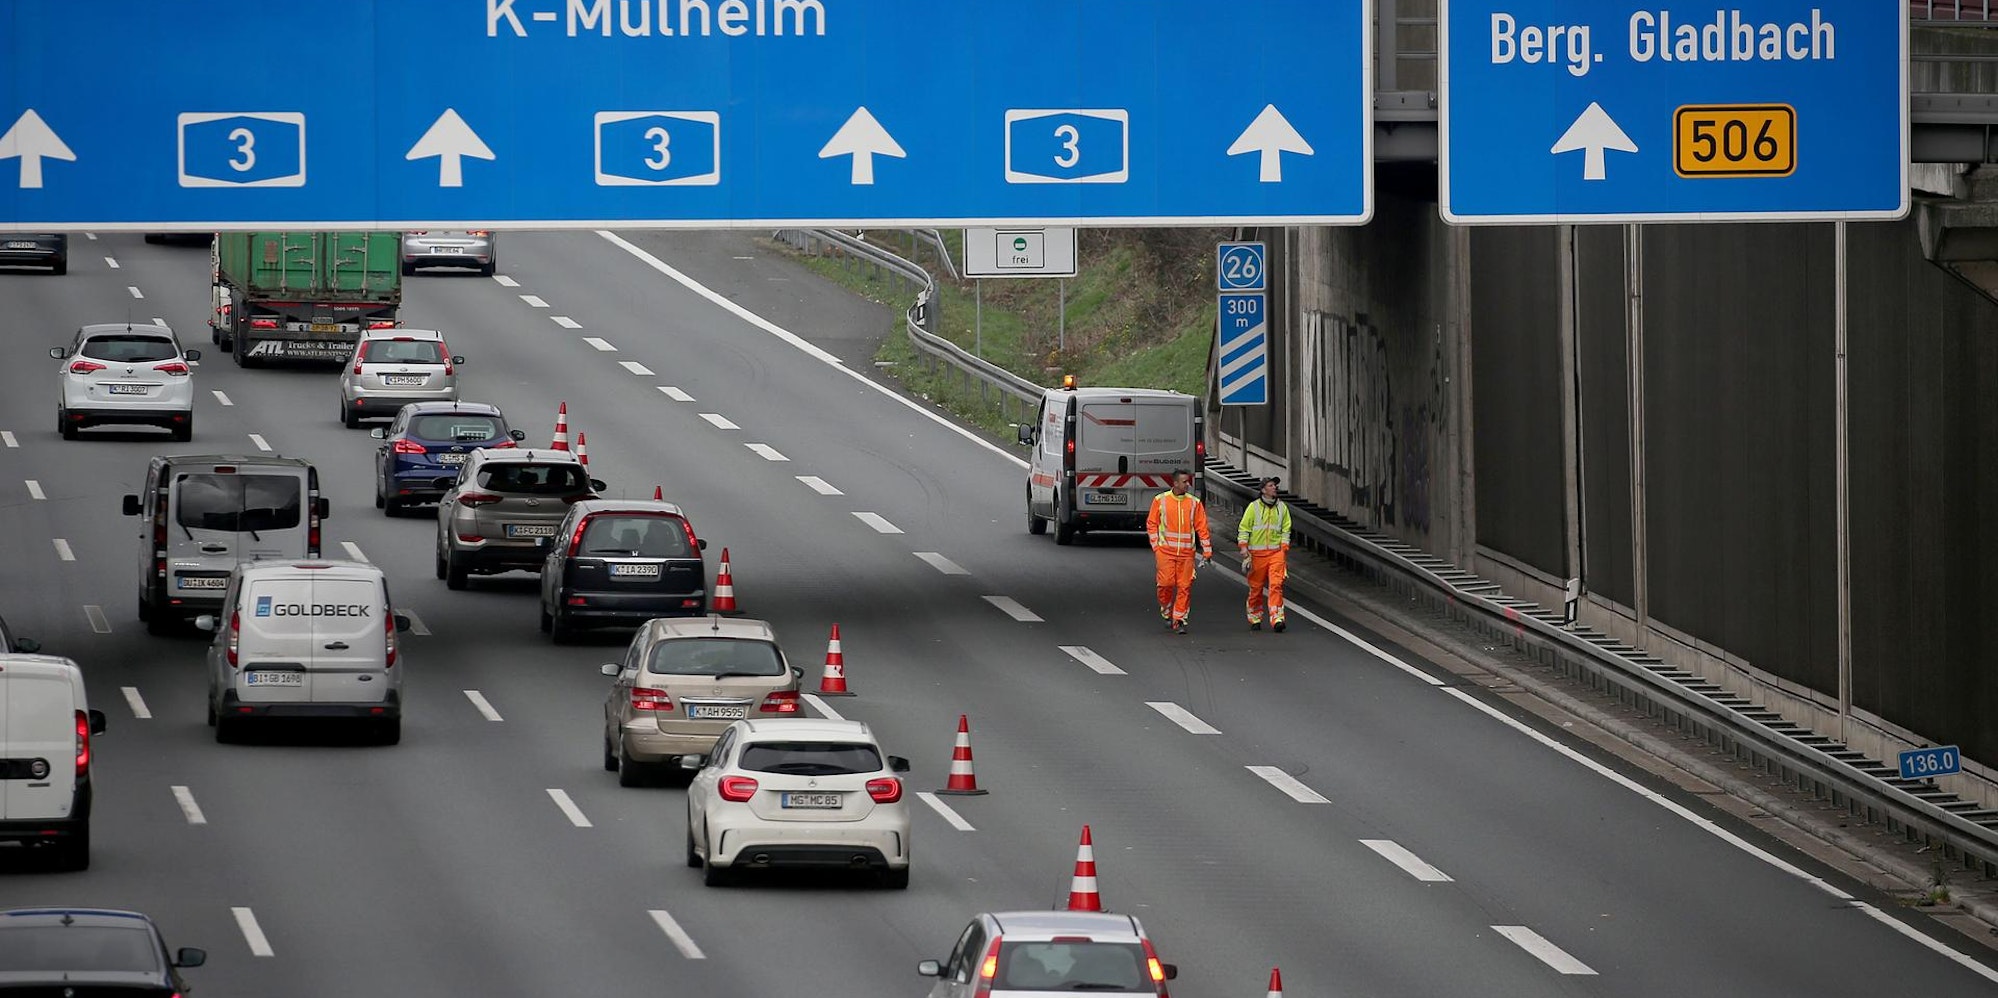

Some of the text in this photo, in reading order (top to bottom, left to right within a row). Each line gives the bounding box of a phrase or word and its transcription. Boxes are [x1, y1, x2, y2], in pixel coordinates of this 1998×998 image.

[1491, 9, 1836, 76] Berg. Gladbach
[227, 128, 256, 172] 3
[643, 127, 671, 171] 3
[1052, 125, 1081, 169] 3
[1691, 120, 1778, 162] 506
[1012, 255, 1029, 264] frei
[1227, 256, 1256, 279] 26
[1227, 299, 1257, 314] 300
[1236, 318, 1248, 327] m
[249, 341, 284, 356] ATL
[287, 342, 316, 350] Trucks
[317, 343, 325, 351] &
[274, 604, 370, 618] GOLDBECK
[1906, 751, 1954, 774] 136.0
